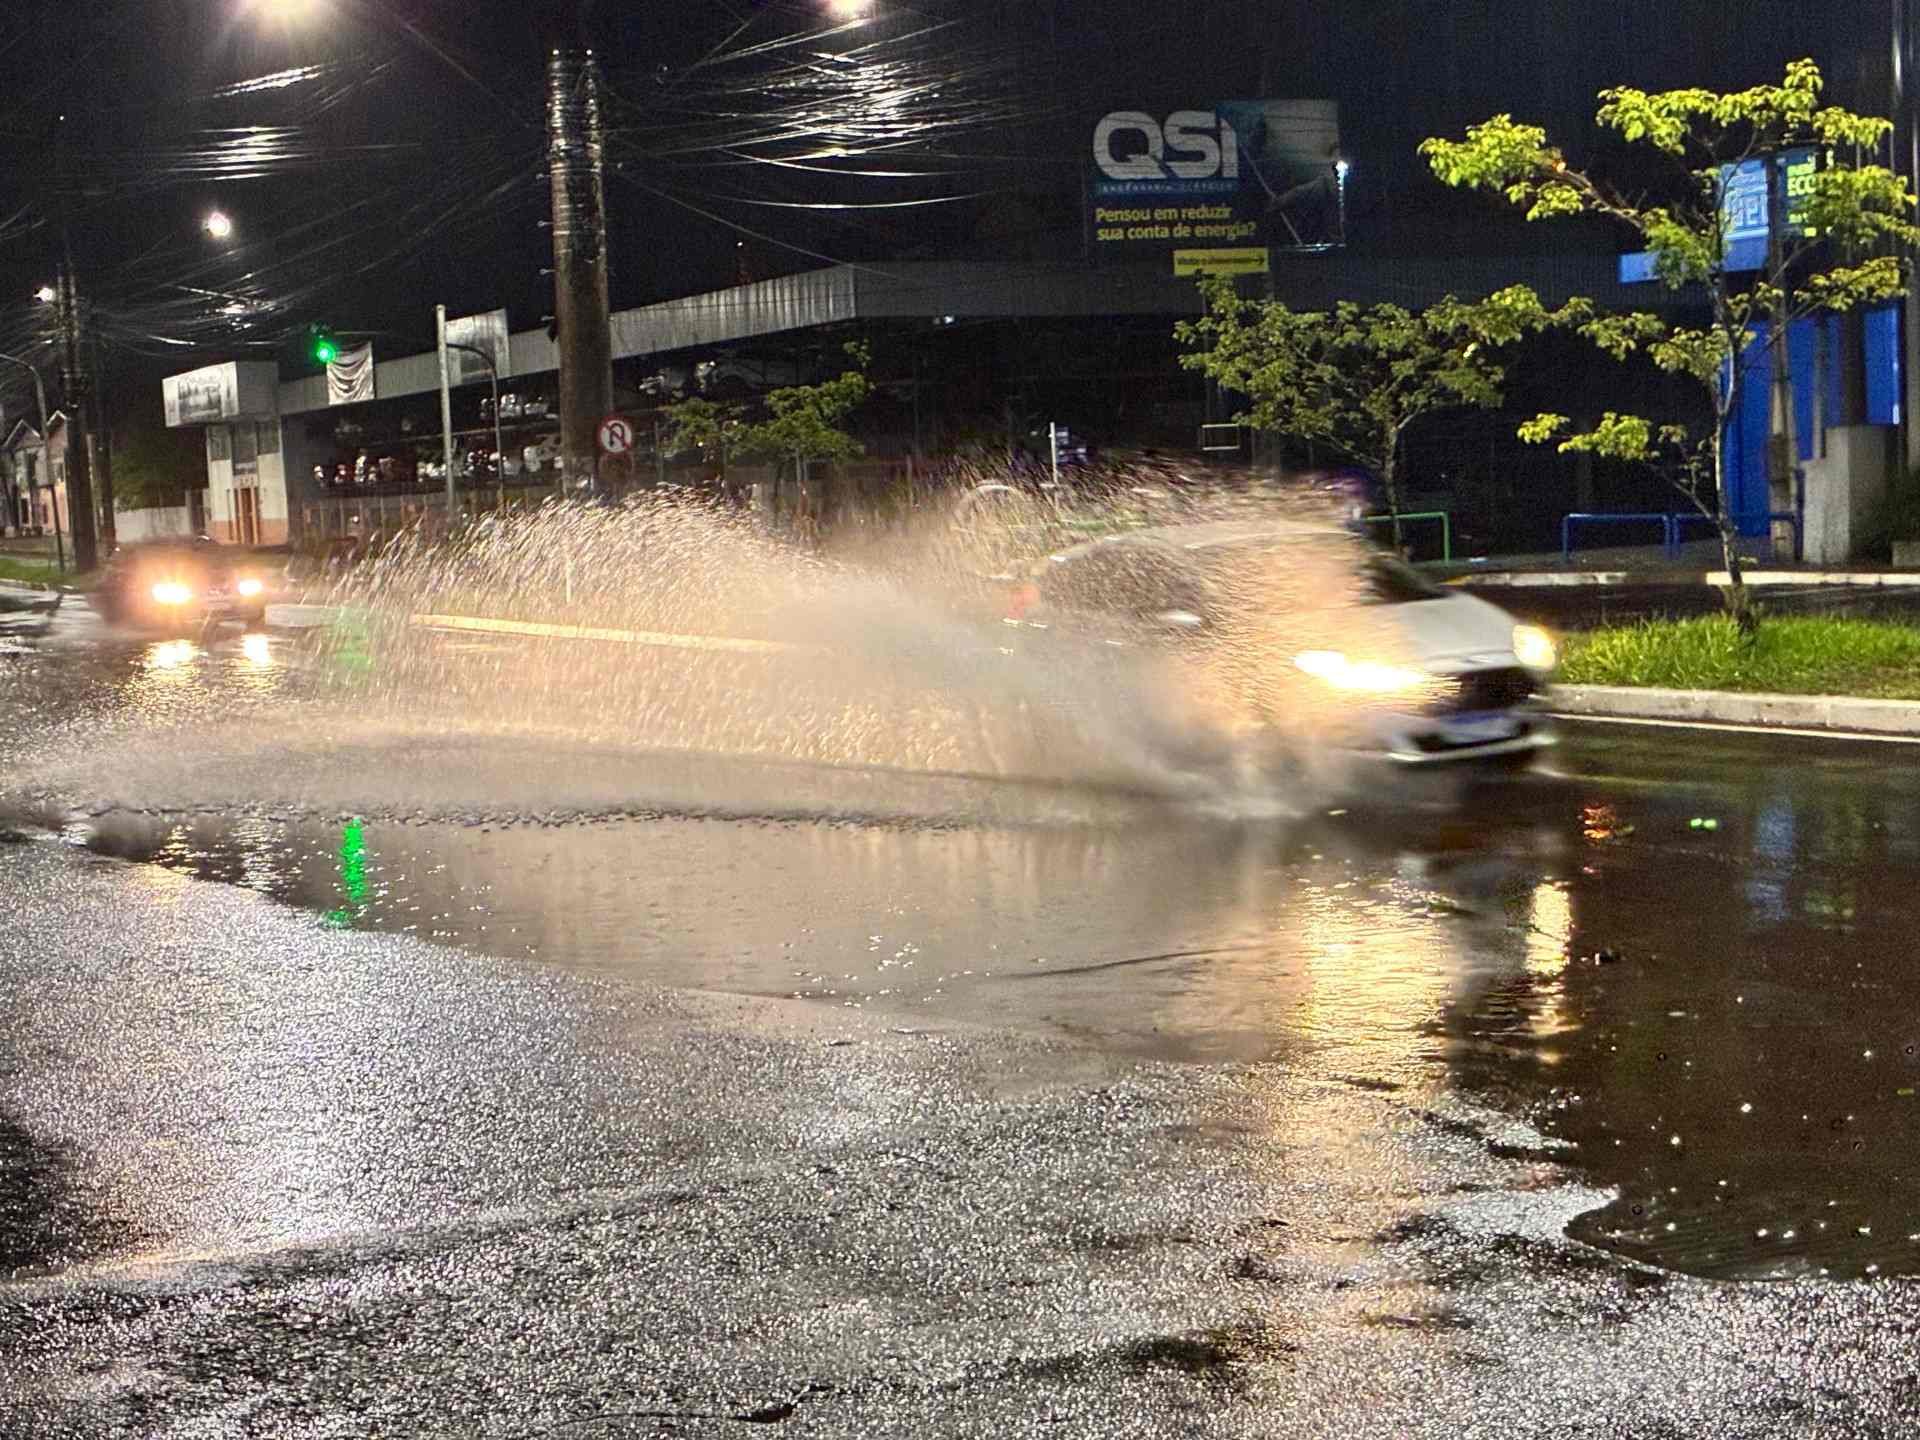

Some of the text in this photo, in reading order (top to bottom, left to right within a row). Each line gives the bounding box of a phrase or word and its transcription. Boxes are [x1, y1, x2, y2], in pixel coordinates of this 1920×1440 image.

[1096, 202, 1232, 222] Pensou em reduzir
[1097, 220, 1257, 241] sua conta de energia?
